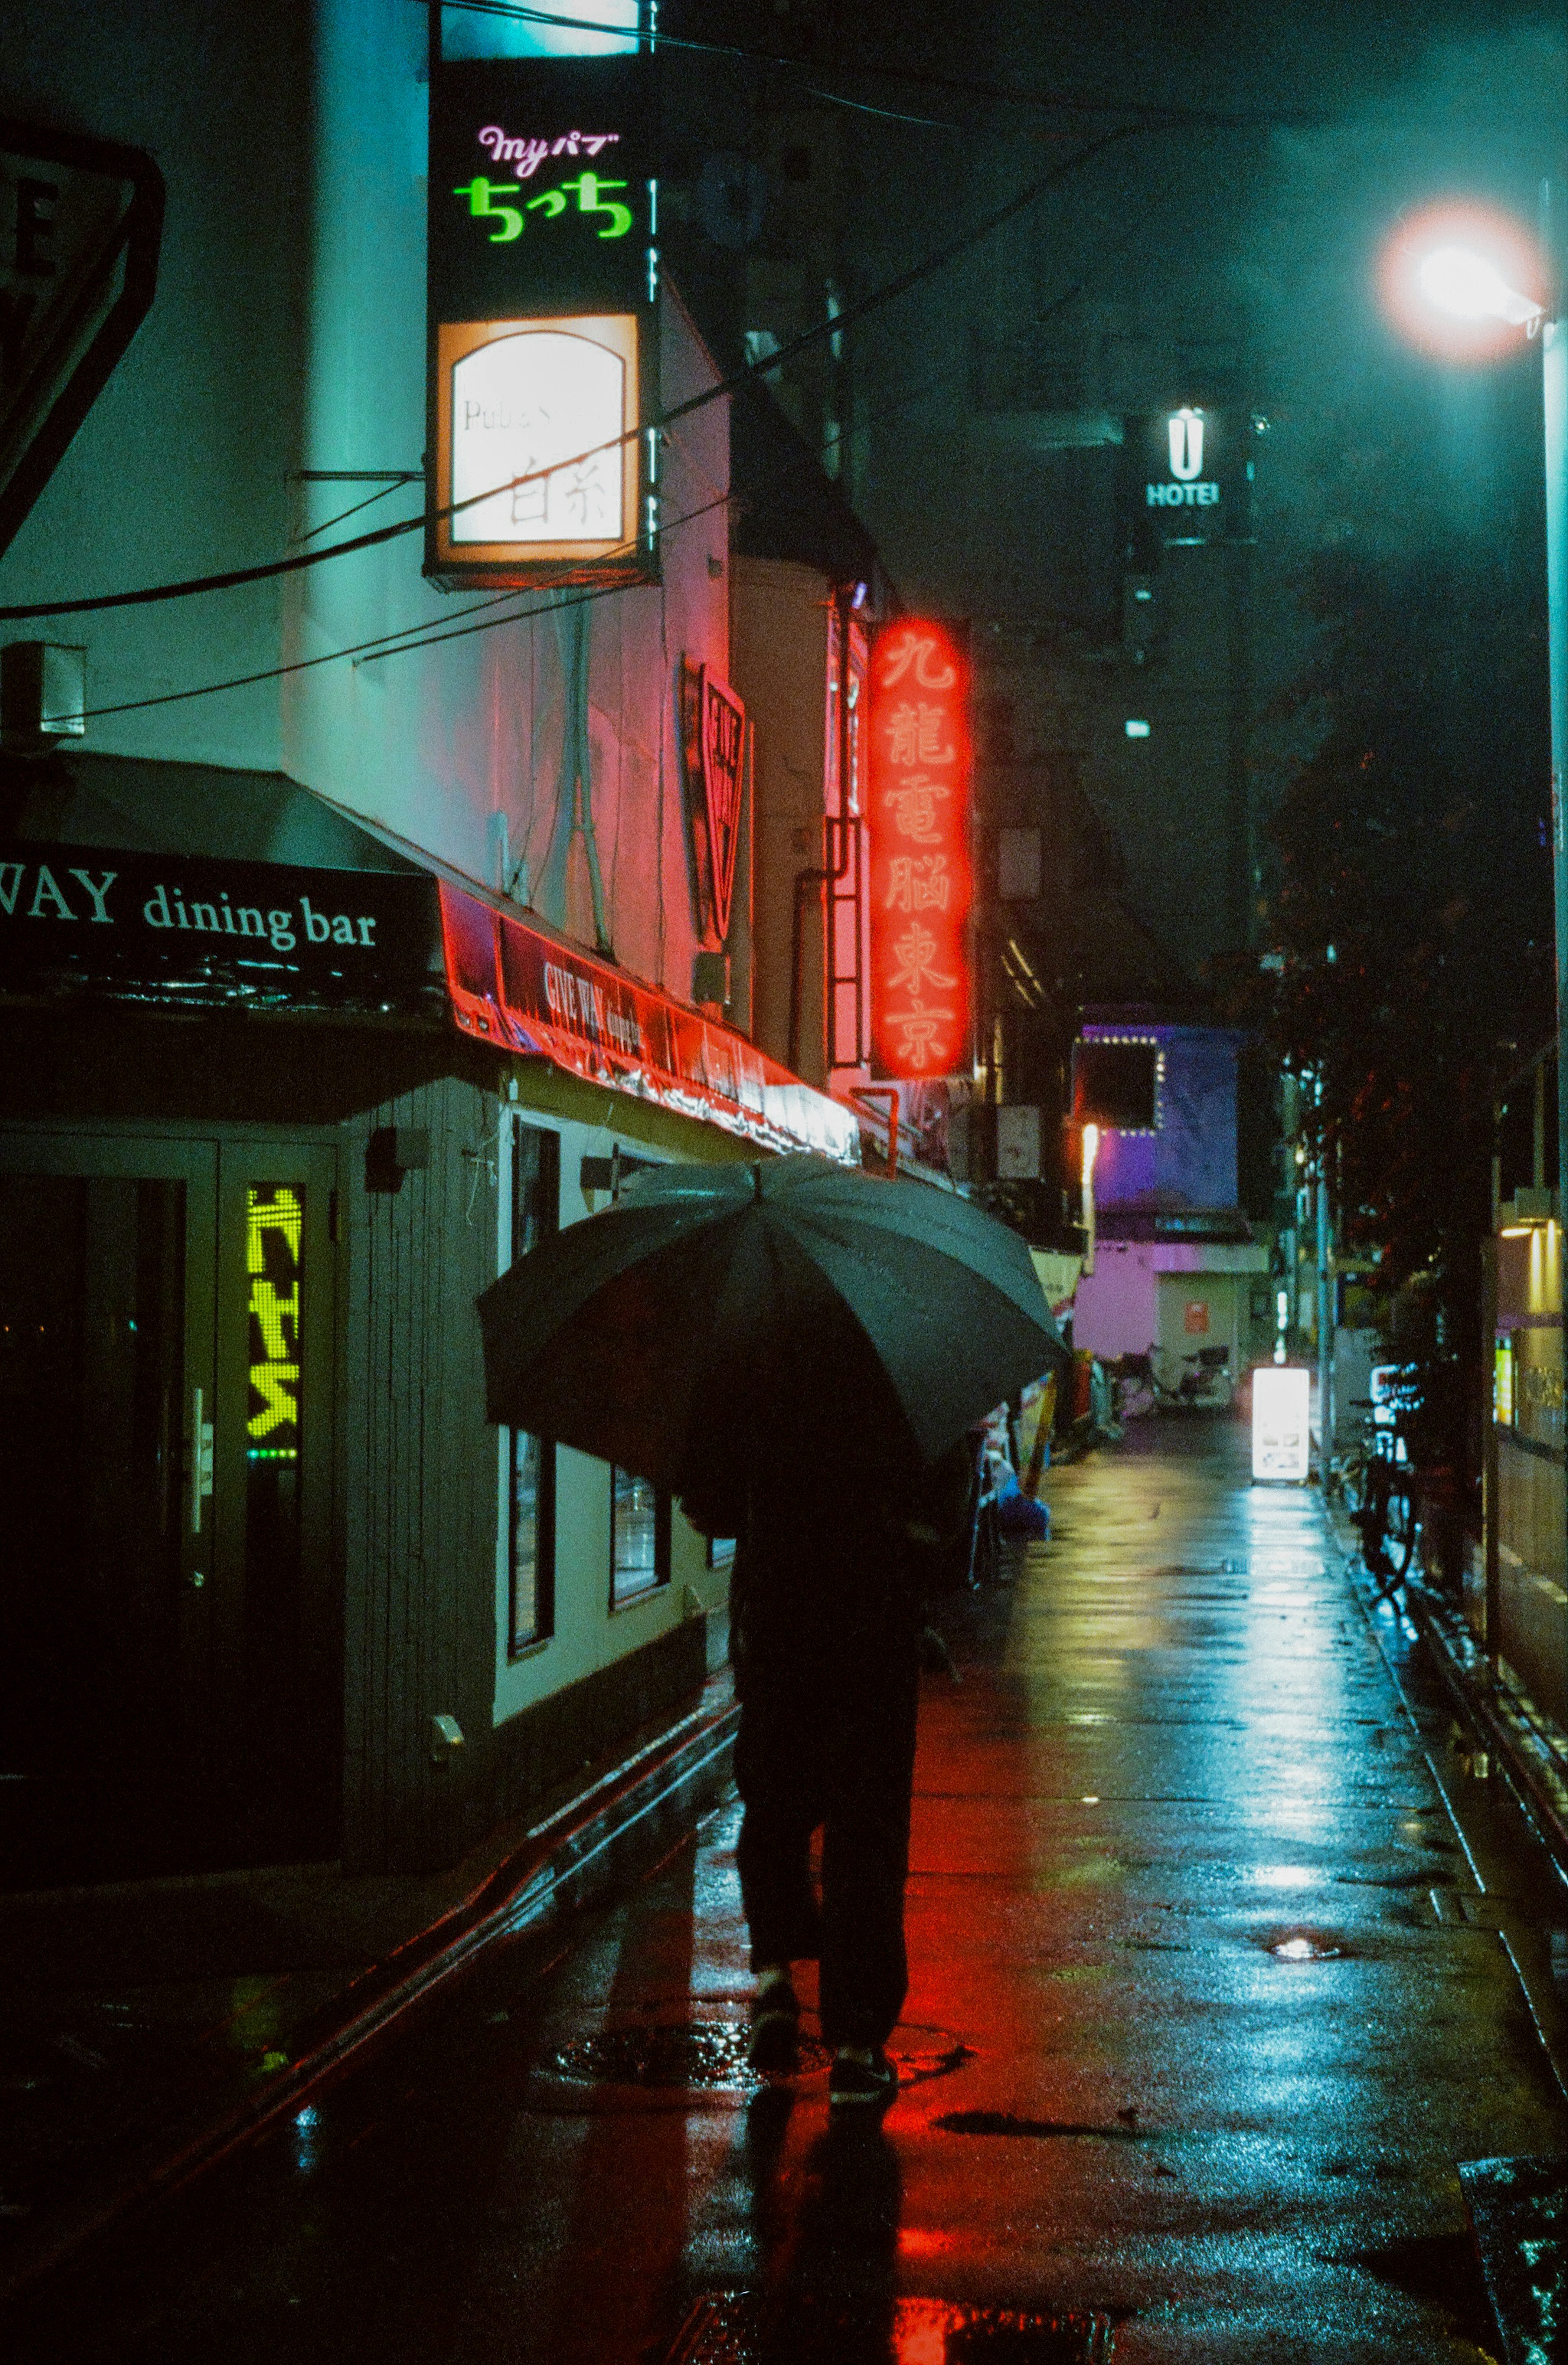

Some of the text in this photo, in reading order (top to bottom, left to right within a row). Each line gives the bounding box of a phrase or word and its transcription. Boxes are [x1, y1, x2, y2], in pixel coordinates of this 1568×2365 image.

[453, 171, 633, 242] ちっち
[883, 631, 956, 1067] 九龍電脳東京
[143, 884, 296, 951] dining
[299, 895, 376, 946] bar
